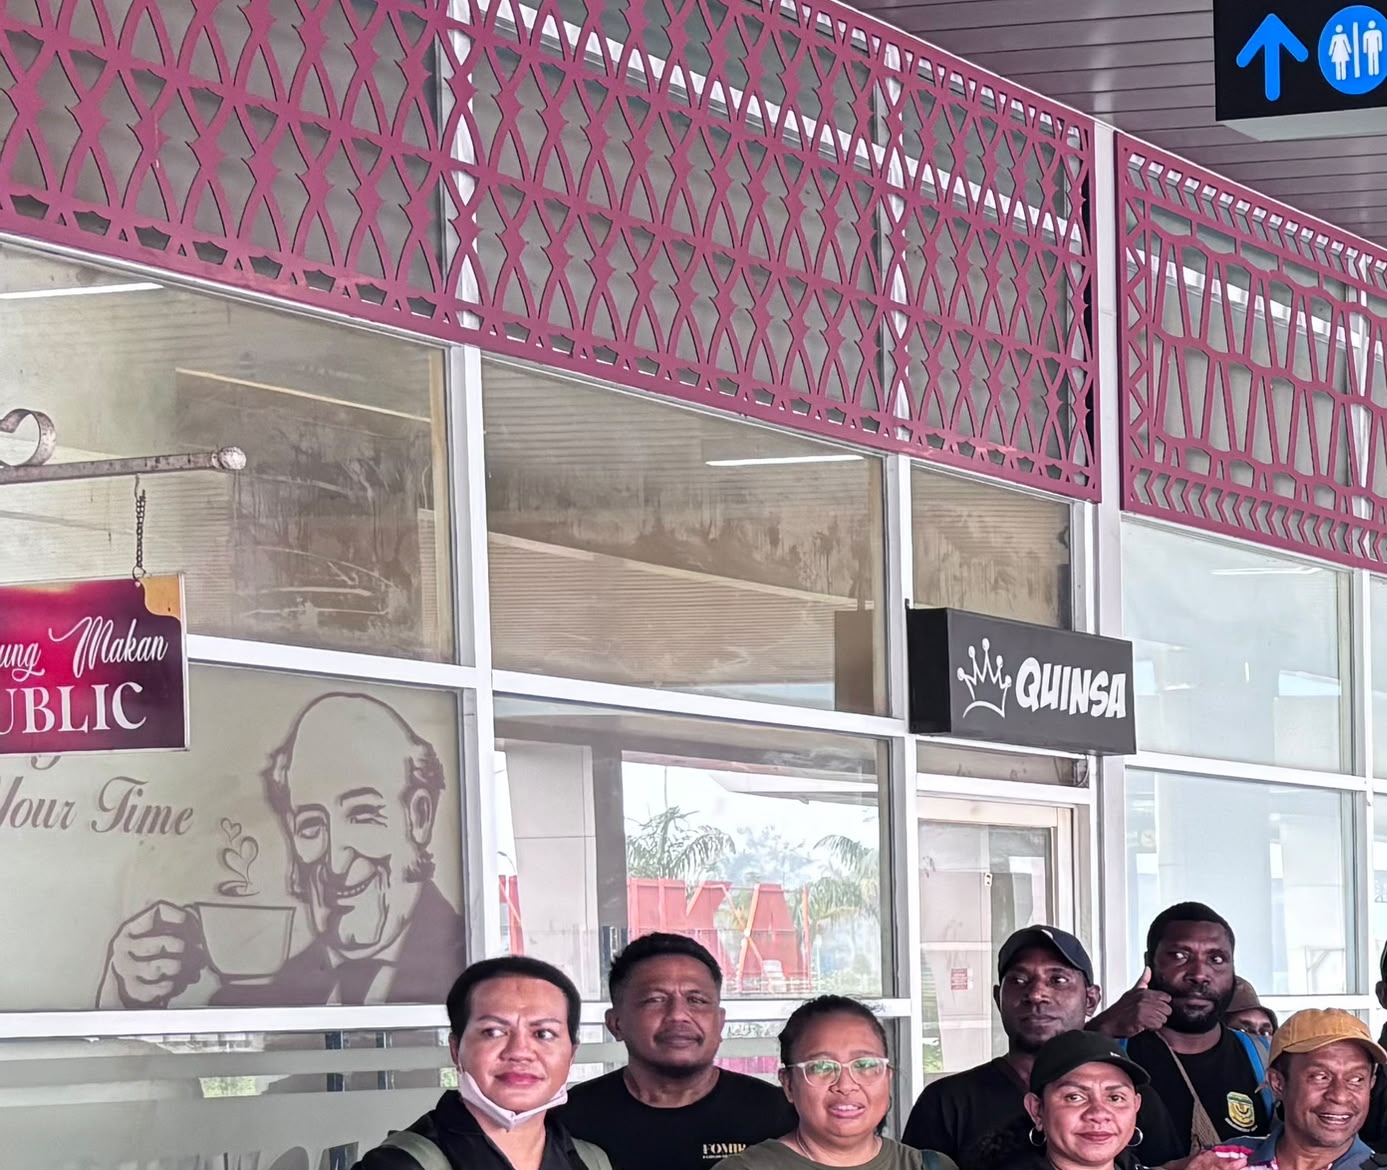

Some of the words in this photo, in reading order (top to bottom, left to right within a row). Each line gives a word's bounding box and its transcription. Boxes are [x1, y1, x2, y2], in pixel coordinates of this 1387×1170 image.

[0, 641, 45, 682] ung
[48, 616, 169, 678] Makan
[1016, 657, 1126, 719] QUINSA
[91, 776, 194, 835] Time
